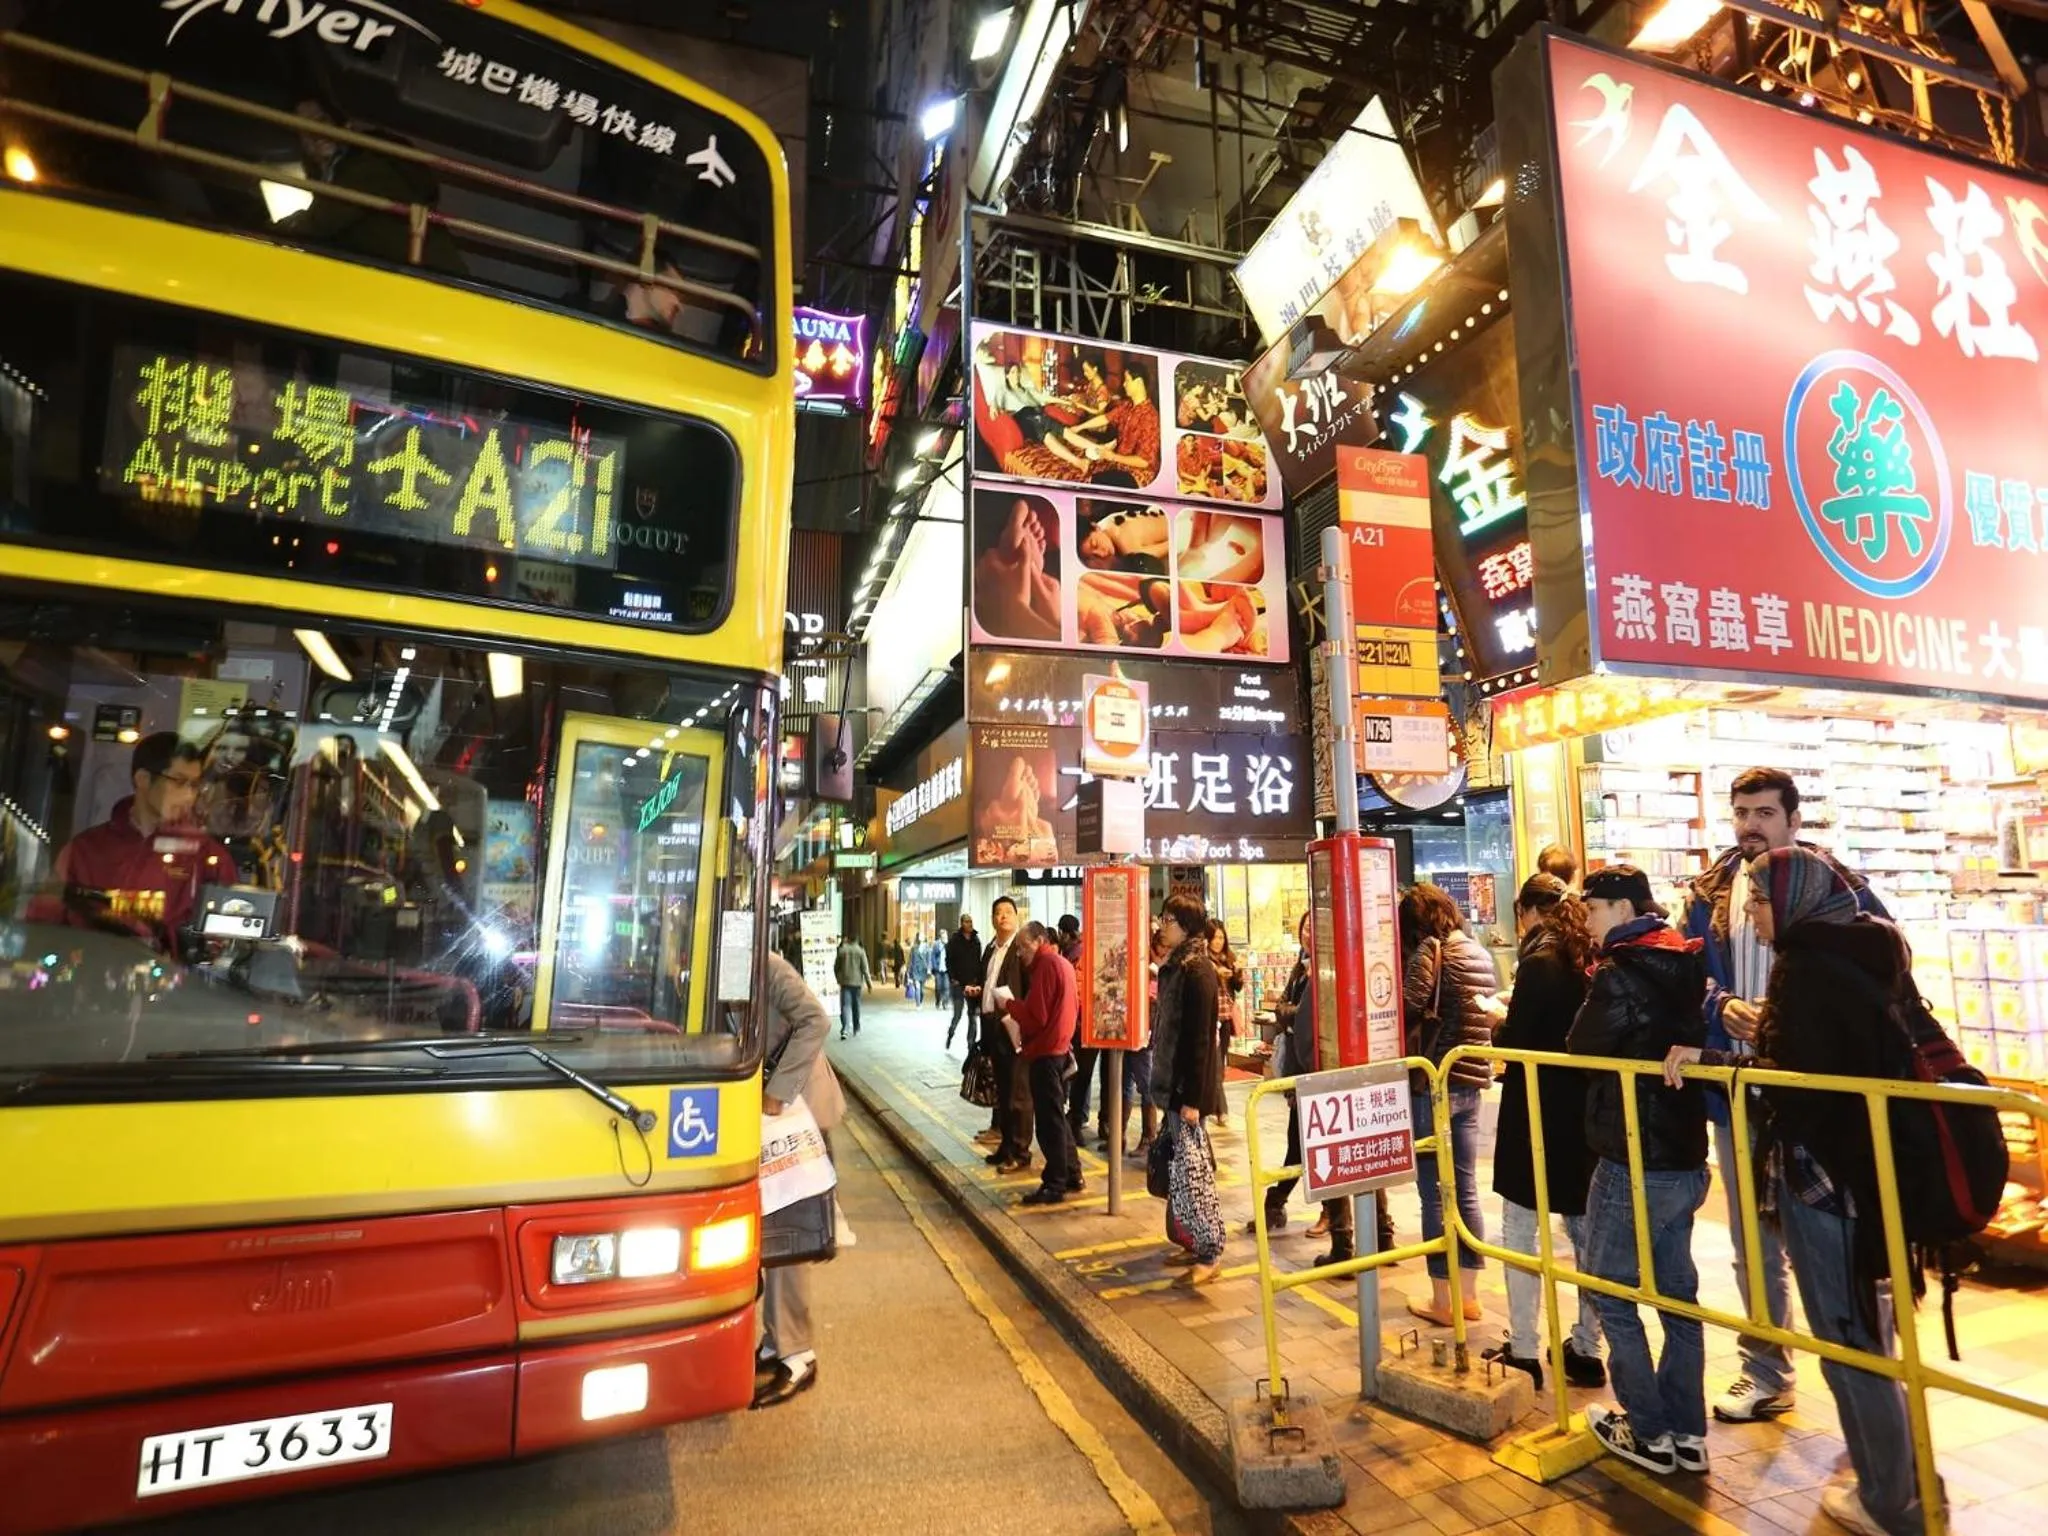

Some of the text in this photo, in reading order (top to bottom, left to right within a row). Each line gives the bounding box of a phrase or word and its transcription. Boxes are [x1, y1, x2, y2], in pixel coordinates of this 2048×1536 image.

[437, 47, 677, 155] 城巴機場快線
[1628, 103, 2038, 362] 金燕莊
[137, 355, 355, 468] 機場
[124, 438, 351, 517] Airport
[453, 428, 616, 556] A21
[1821, 381, 1932, 562] 藥
[1352, 527, 1384, 546] A21
[1965, 470, 2048, 556] 優質
[1611, 574, 1794, 656] 燕窩蟲草
[1803, 601, 1973, 676] MEDICINE
[1366, 718, 1391, 740] N796
[1306, 1093, 1354, 1139] A21
[1338, 1135, 1404, 1164] 請在此排隊
[1356, 1108, 1408, 1128] to Airport
[1337, 1155, 1408, 1177] Please queue here
[149, 1410, 378, 1485] HT 3633
